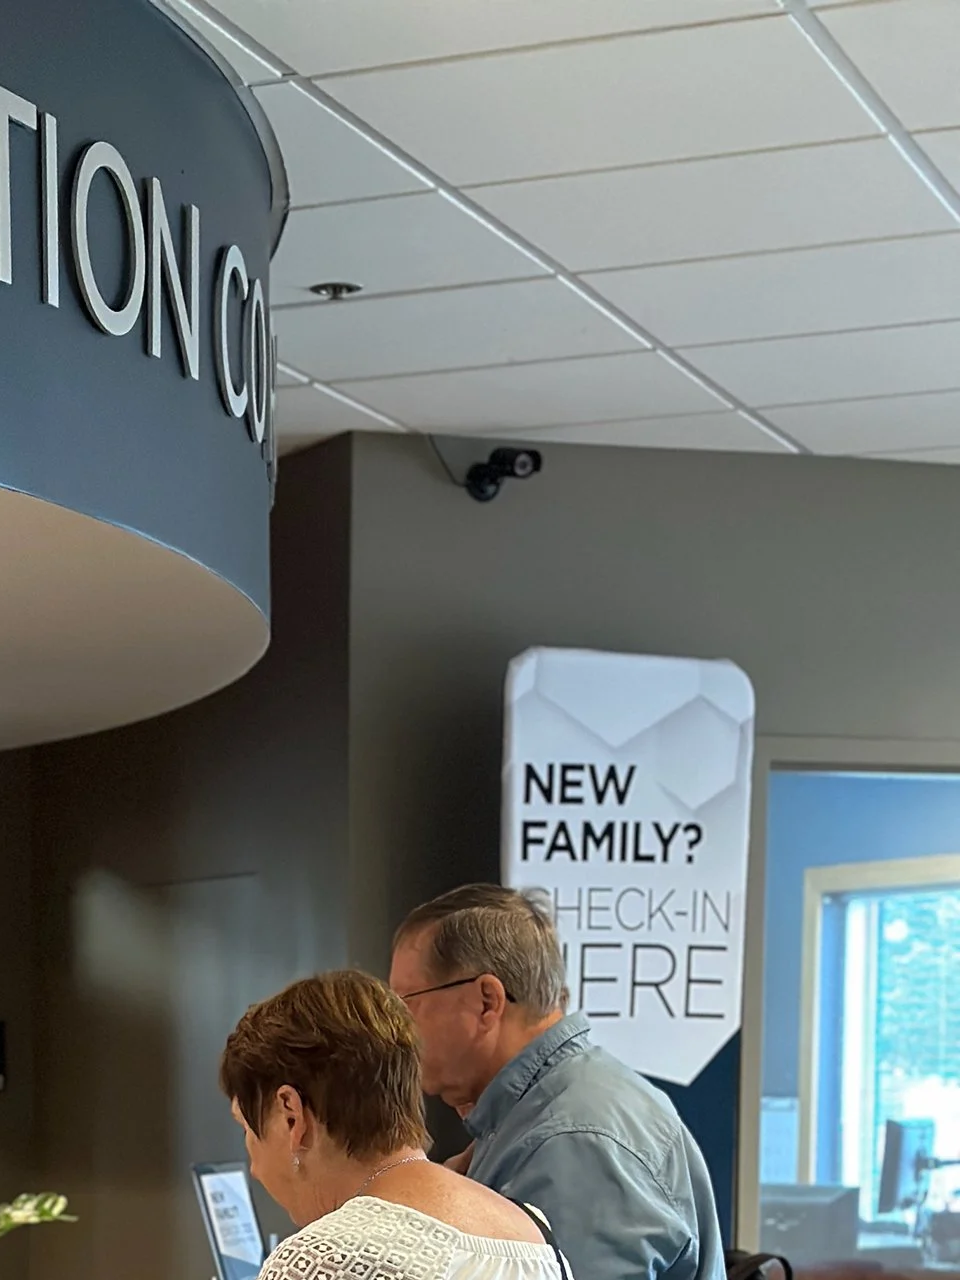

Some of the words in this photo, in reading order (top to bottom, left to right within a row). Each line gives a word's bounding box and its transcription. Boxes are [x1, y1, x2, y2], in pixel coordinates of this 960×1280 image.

[523, 764, 637, 805] NEW
[520, 821, 704, 864] FAMILY?
[562, 942, 728, 1018] ERE
